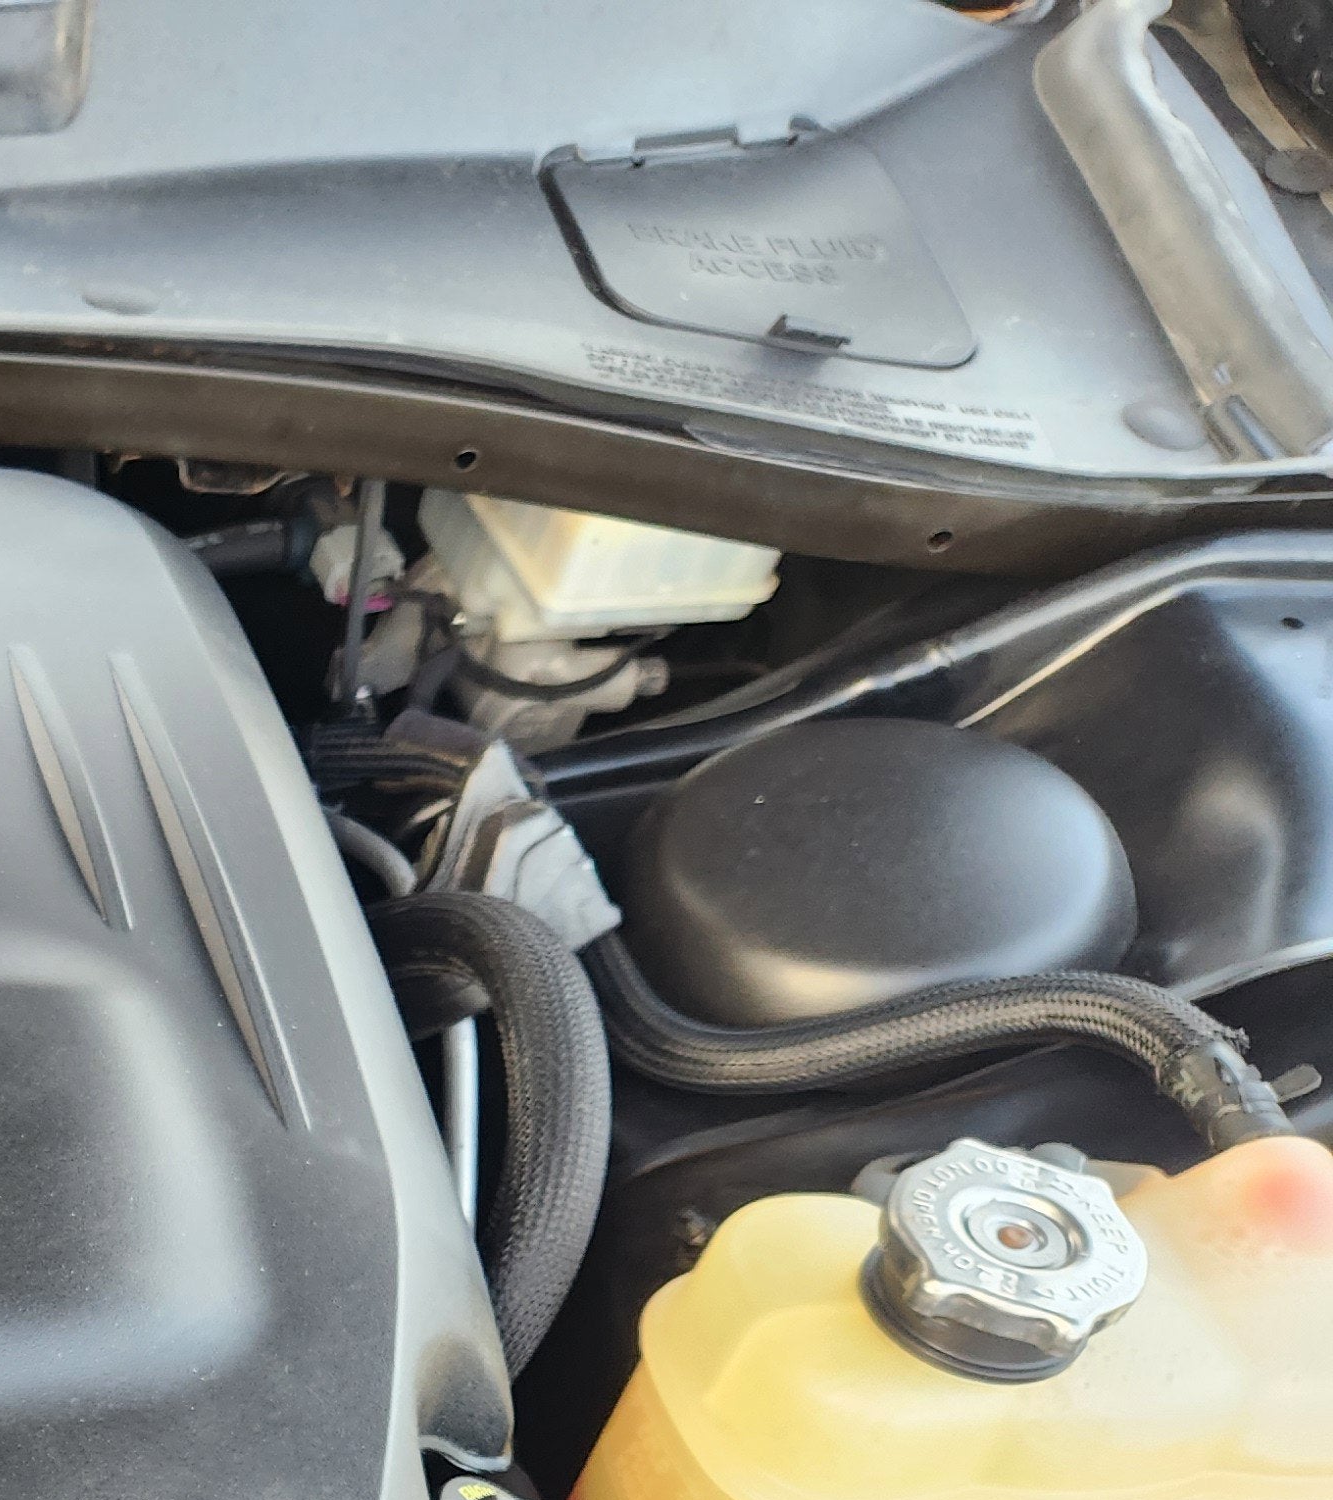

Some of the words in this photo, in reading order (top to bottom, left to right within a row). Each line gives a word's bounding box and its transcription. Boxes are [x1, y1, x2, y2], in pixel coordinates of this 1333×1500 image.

[627, 222, 757, 255] BRAKE
[765, 234, 883, 262] FLUID
[689, 253, 840, 284] ACCESS
[923, 1160, 973, 1191] NOT
[973, 1156, 1011, 1175] DO
[911, 1188, 947, 1240] OPEN
[1077, 1197, 1130, 1256] KEEP
[942, 1242, 1000, 1284] HOT
[1065, 1262, 1127, 1302] TIGHT
